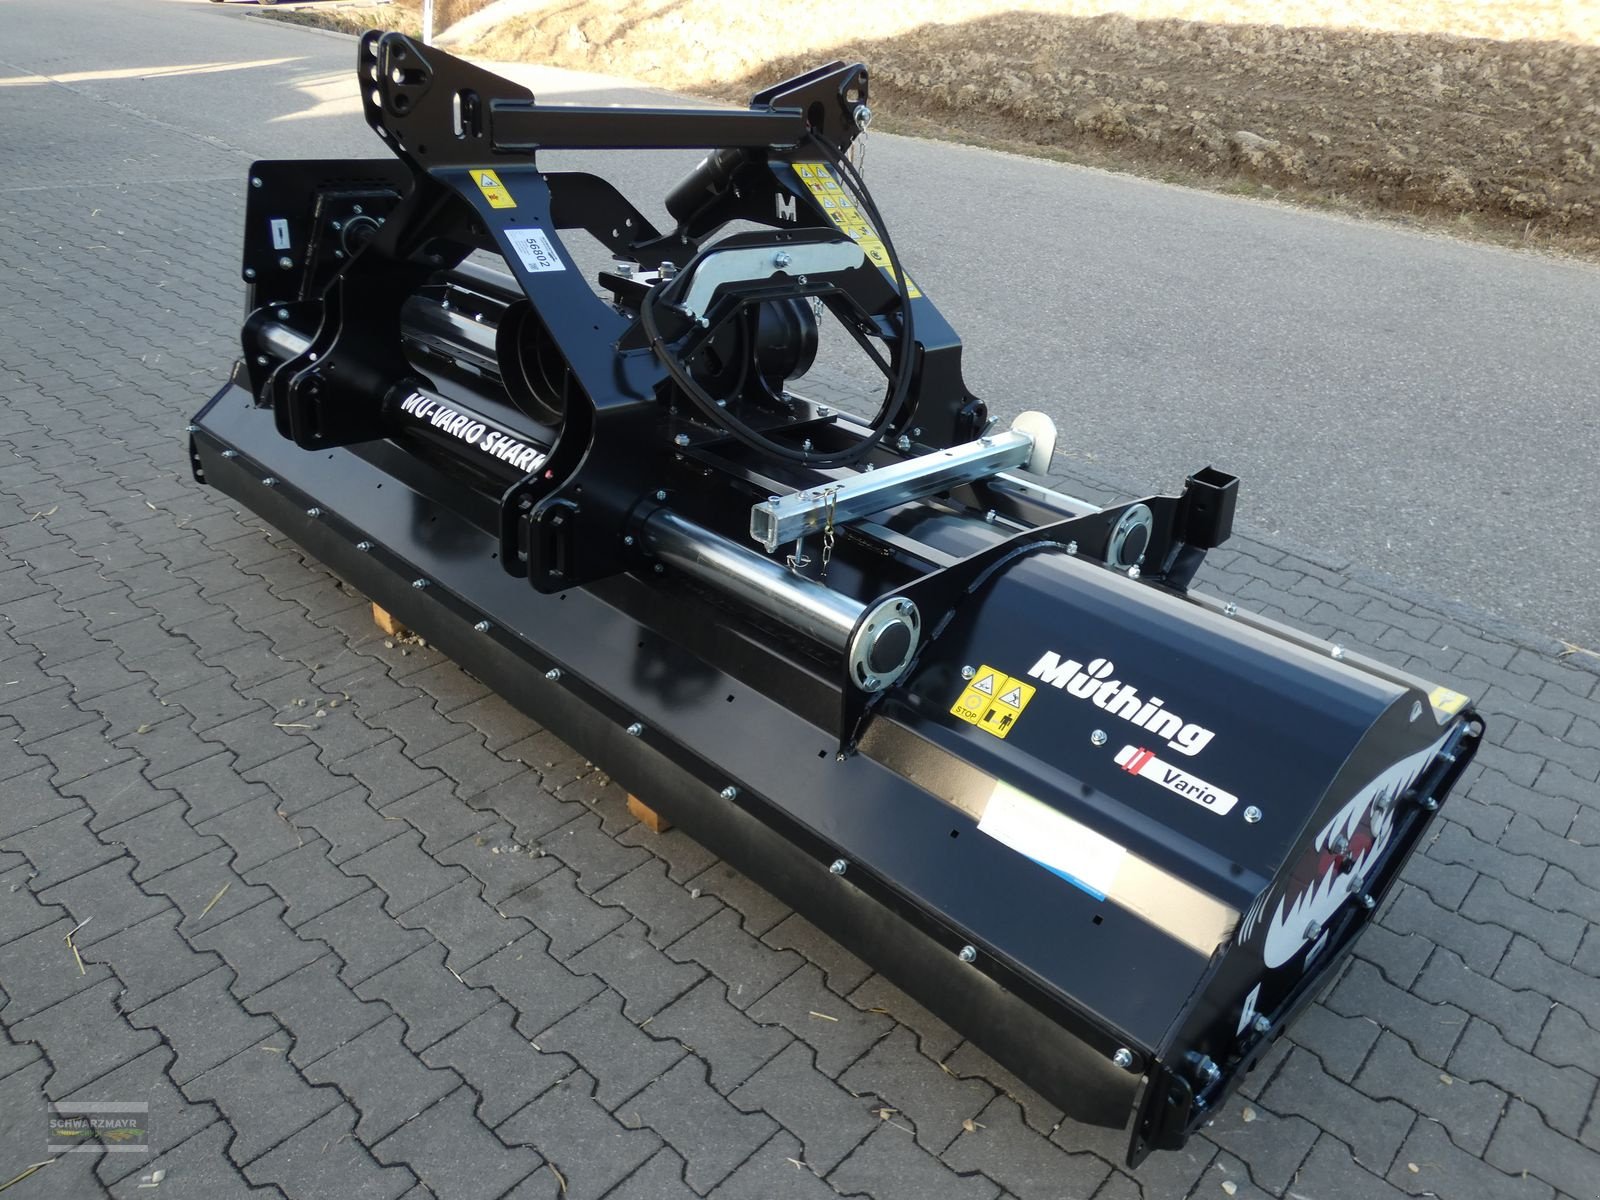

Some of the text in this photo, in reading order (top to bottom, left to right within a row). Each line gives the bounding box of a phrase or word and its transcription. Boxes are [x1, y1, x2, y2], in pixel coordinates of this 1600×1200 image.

[526, 238, 551, 267] 56802
[400, 392, 485, 444] MU-VARIO
[955, 705, 978, 720] STOP
[1162, 768, 1217, 806] Vario
